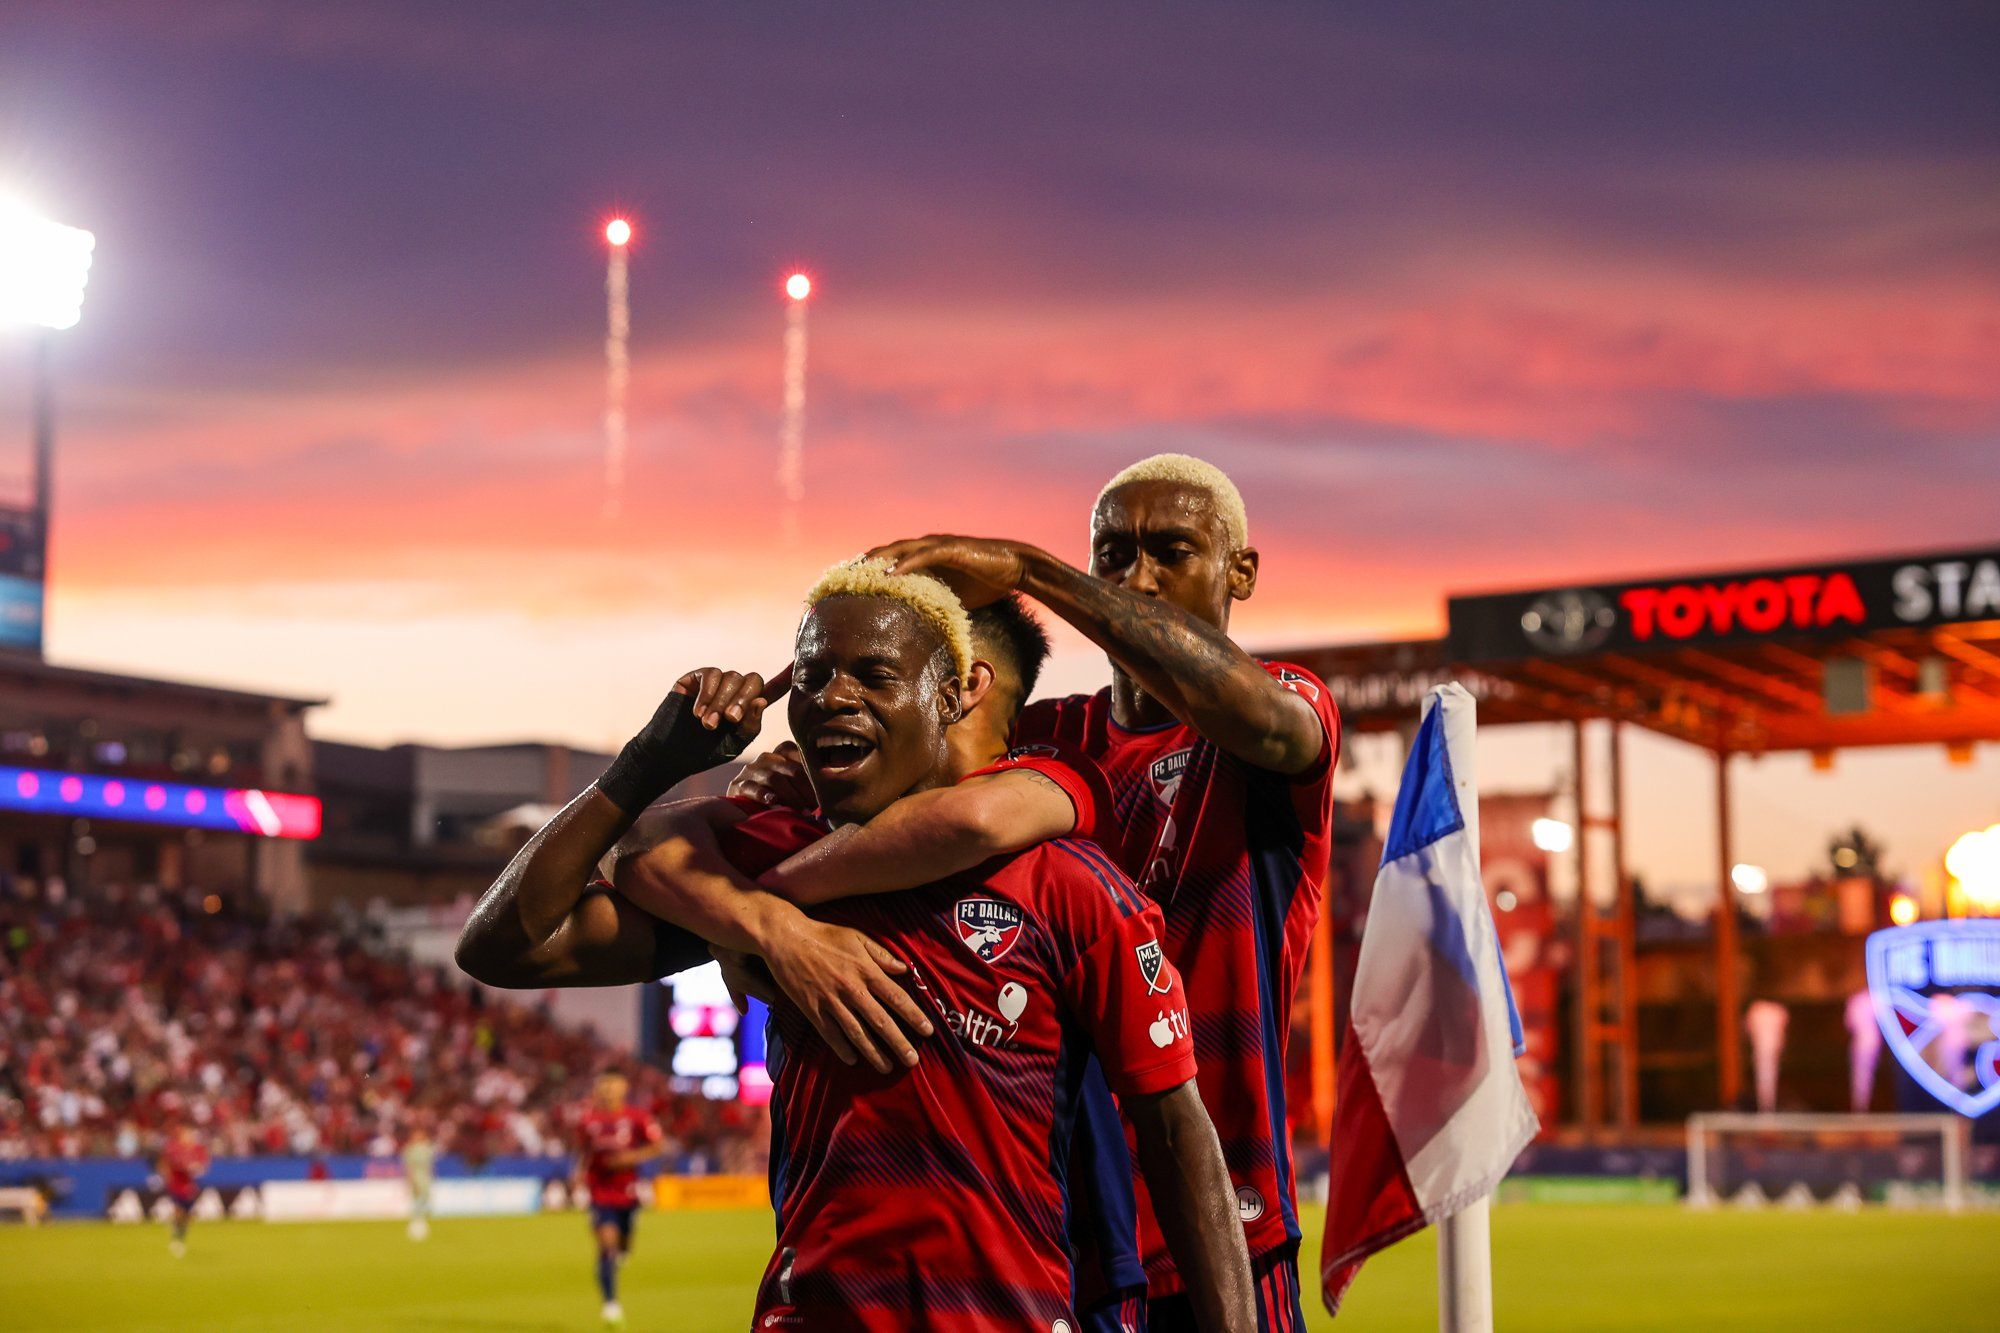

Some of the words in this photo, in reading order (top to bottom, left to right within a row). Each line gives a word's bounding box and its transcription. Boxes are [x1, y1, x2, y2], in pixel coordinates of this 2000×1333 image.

[1620, 571, 1866, 641] TOYOTA
[1892, 559, 2000, 623] STA
[1154, 762, 1165, 777] FC
[961, 903, 975, 918] FC
[979, 903, 1018, 922] DALLAS
[1140, 944, 1160, 961] MLS
[1170, 1008, 1188, 1039] tv
[1239, 1197, 1256, 1210] LH
